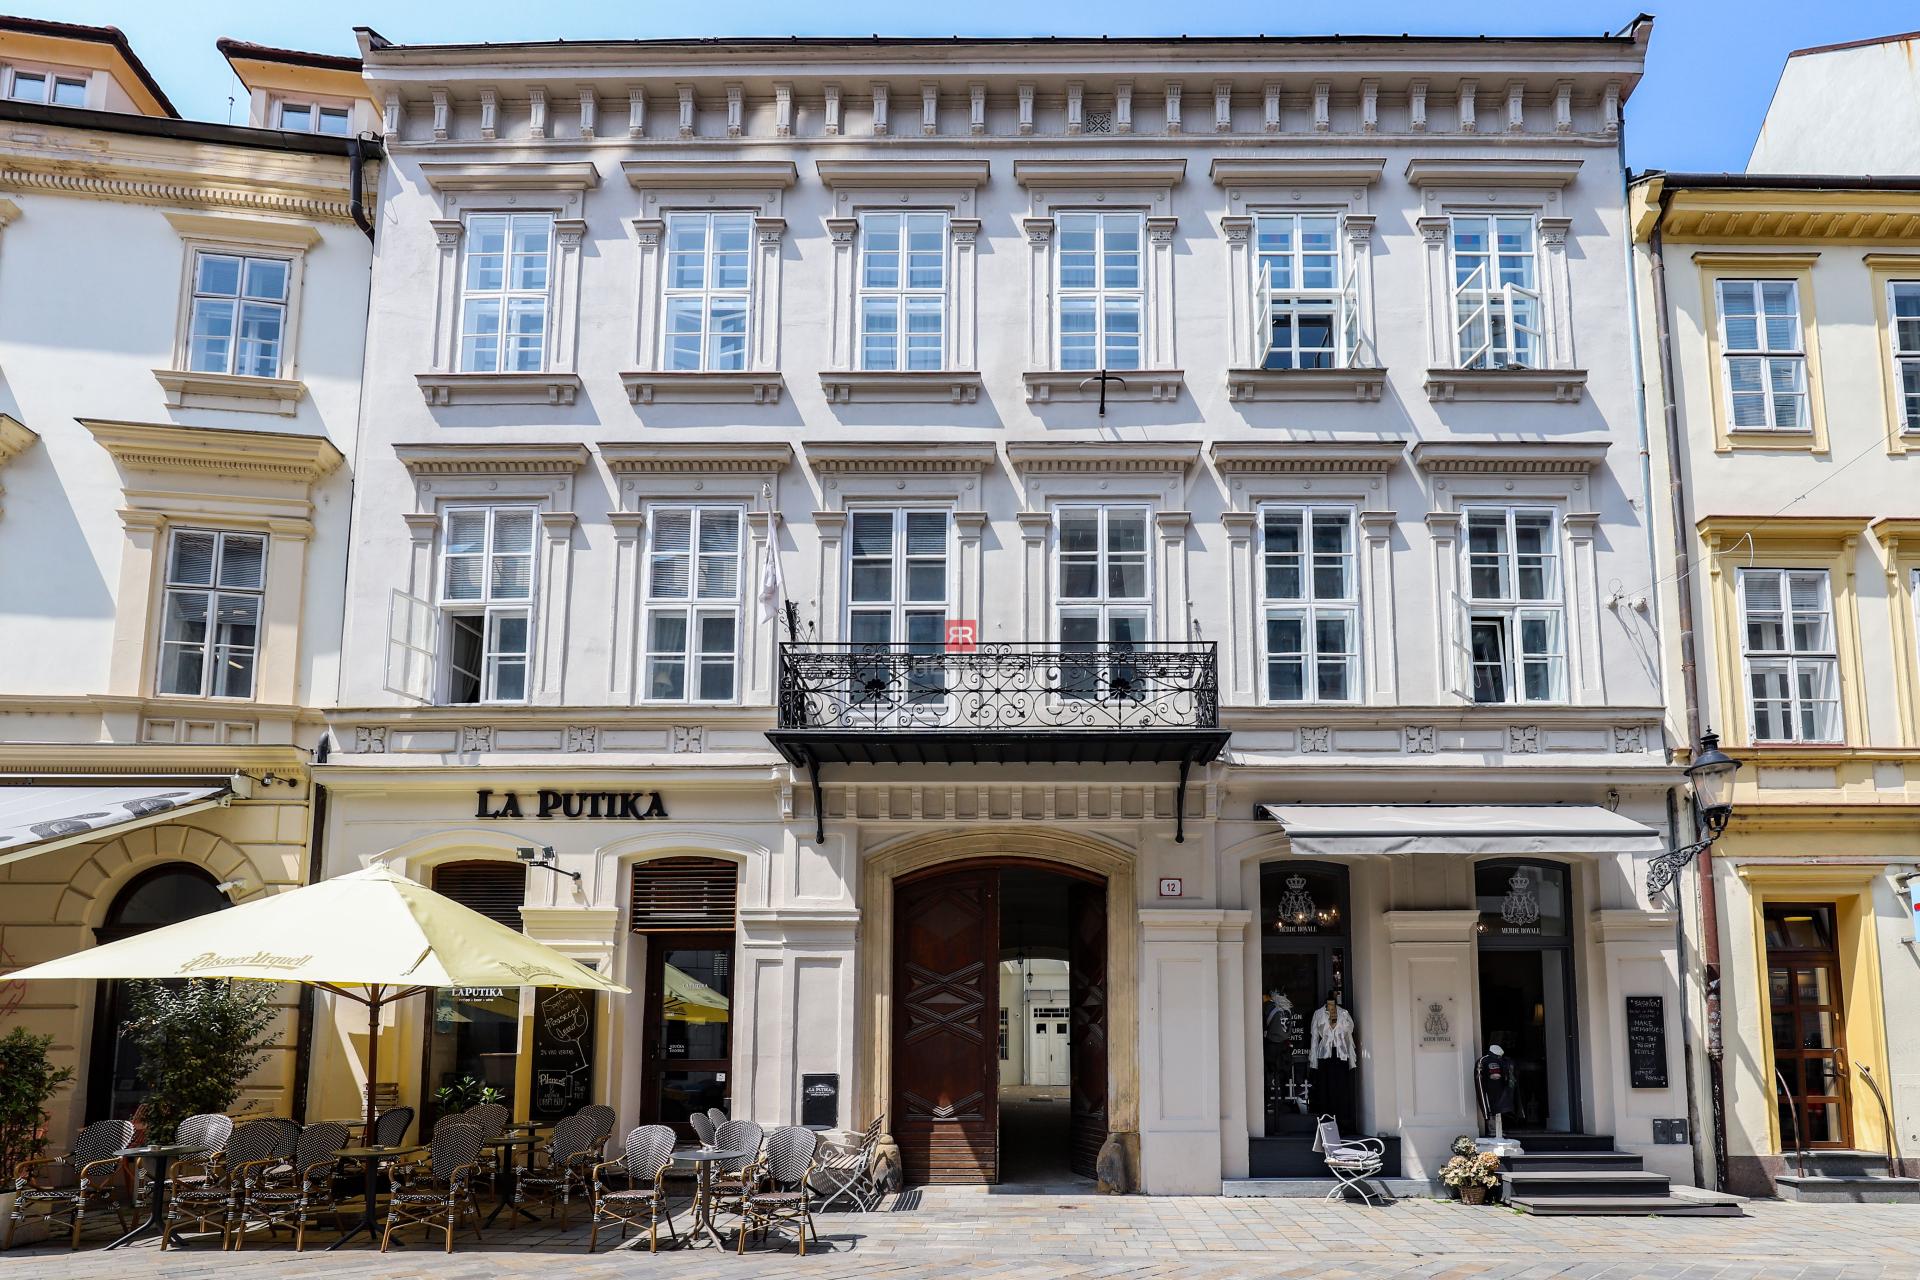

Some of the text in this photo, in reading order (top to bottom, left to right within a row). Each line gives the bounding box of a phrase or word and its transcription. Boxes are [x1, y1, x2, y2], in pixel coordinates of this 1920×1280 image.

[475, 790, 669, 820] LA PUTIKA
[1167, 883, 1176, 892] 12
[179, 950, 314, 974] Pilsner Urquell
